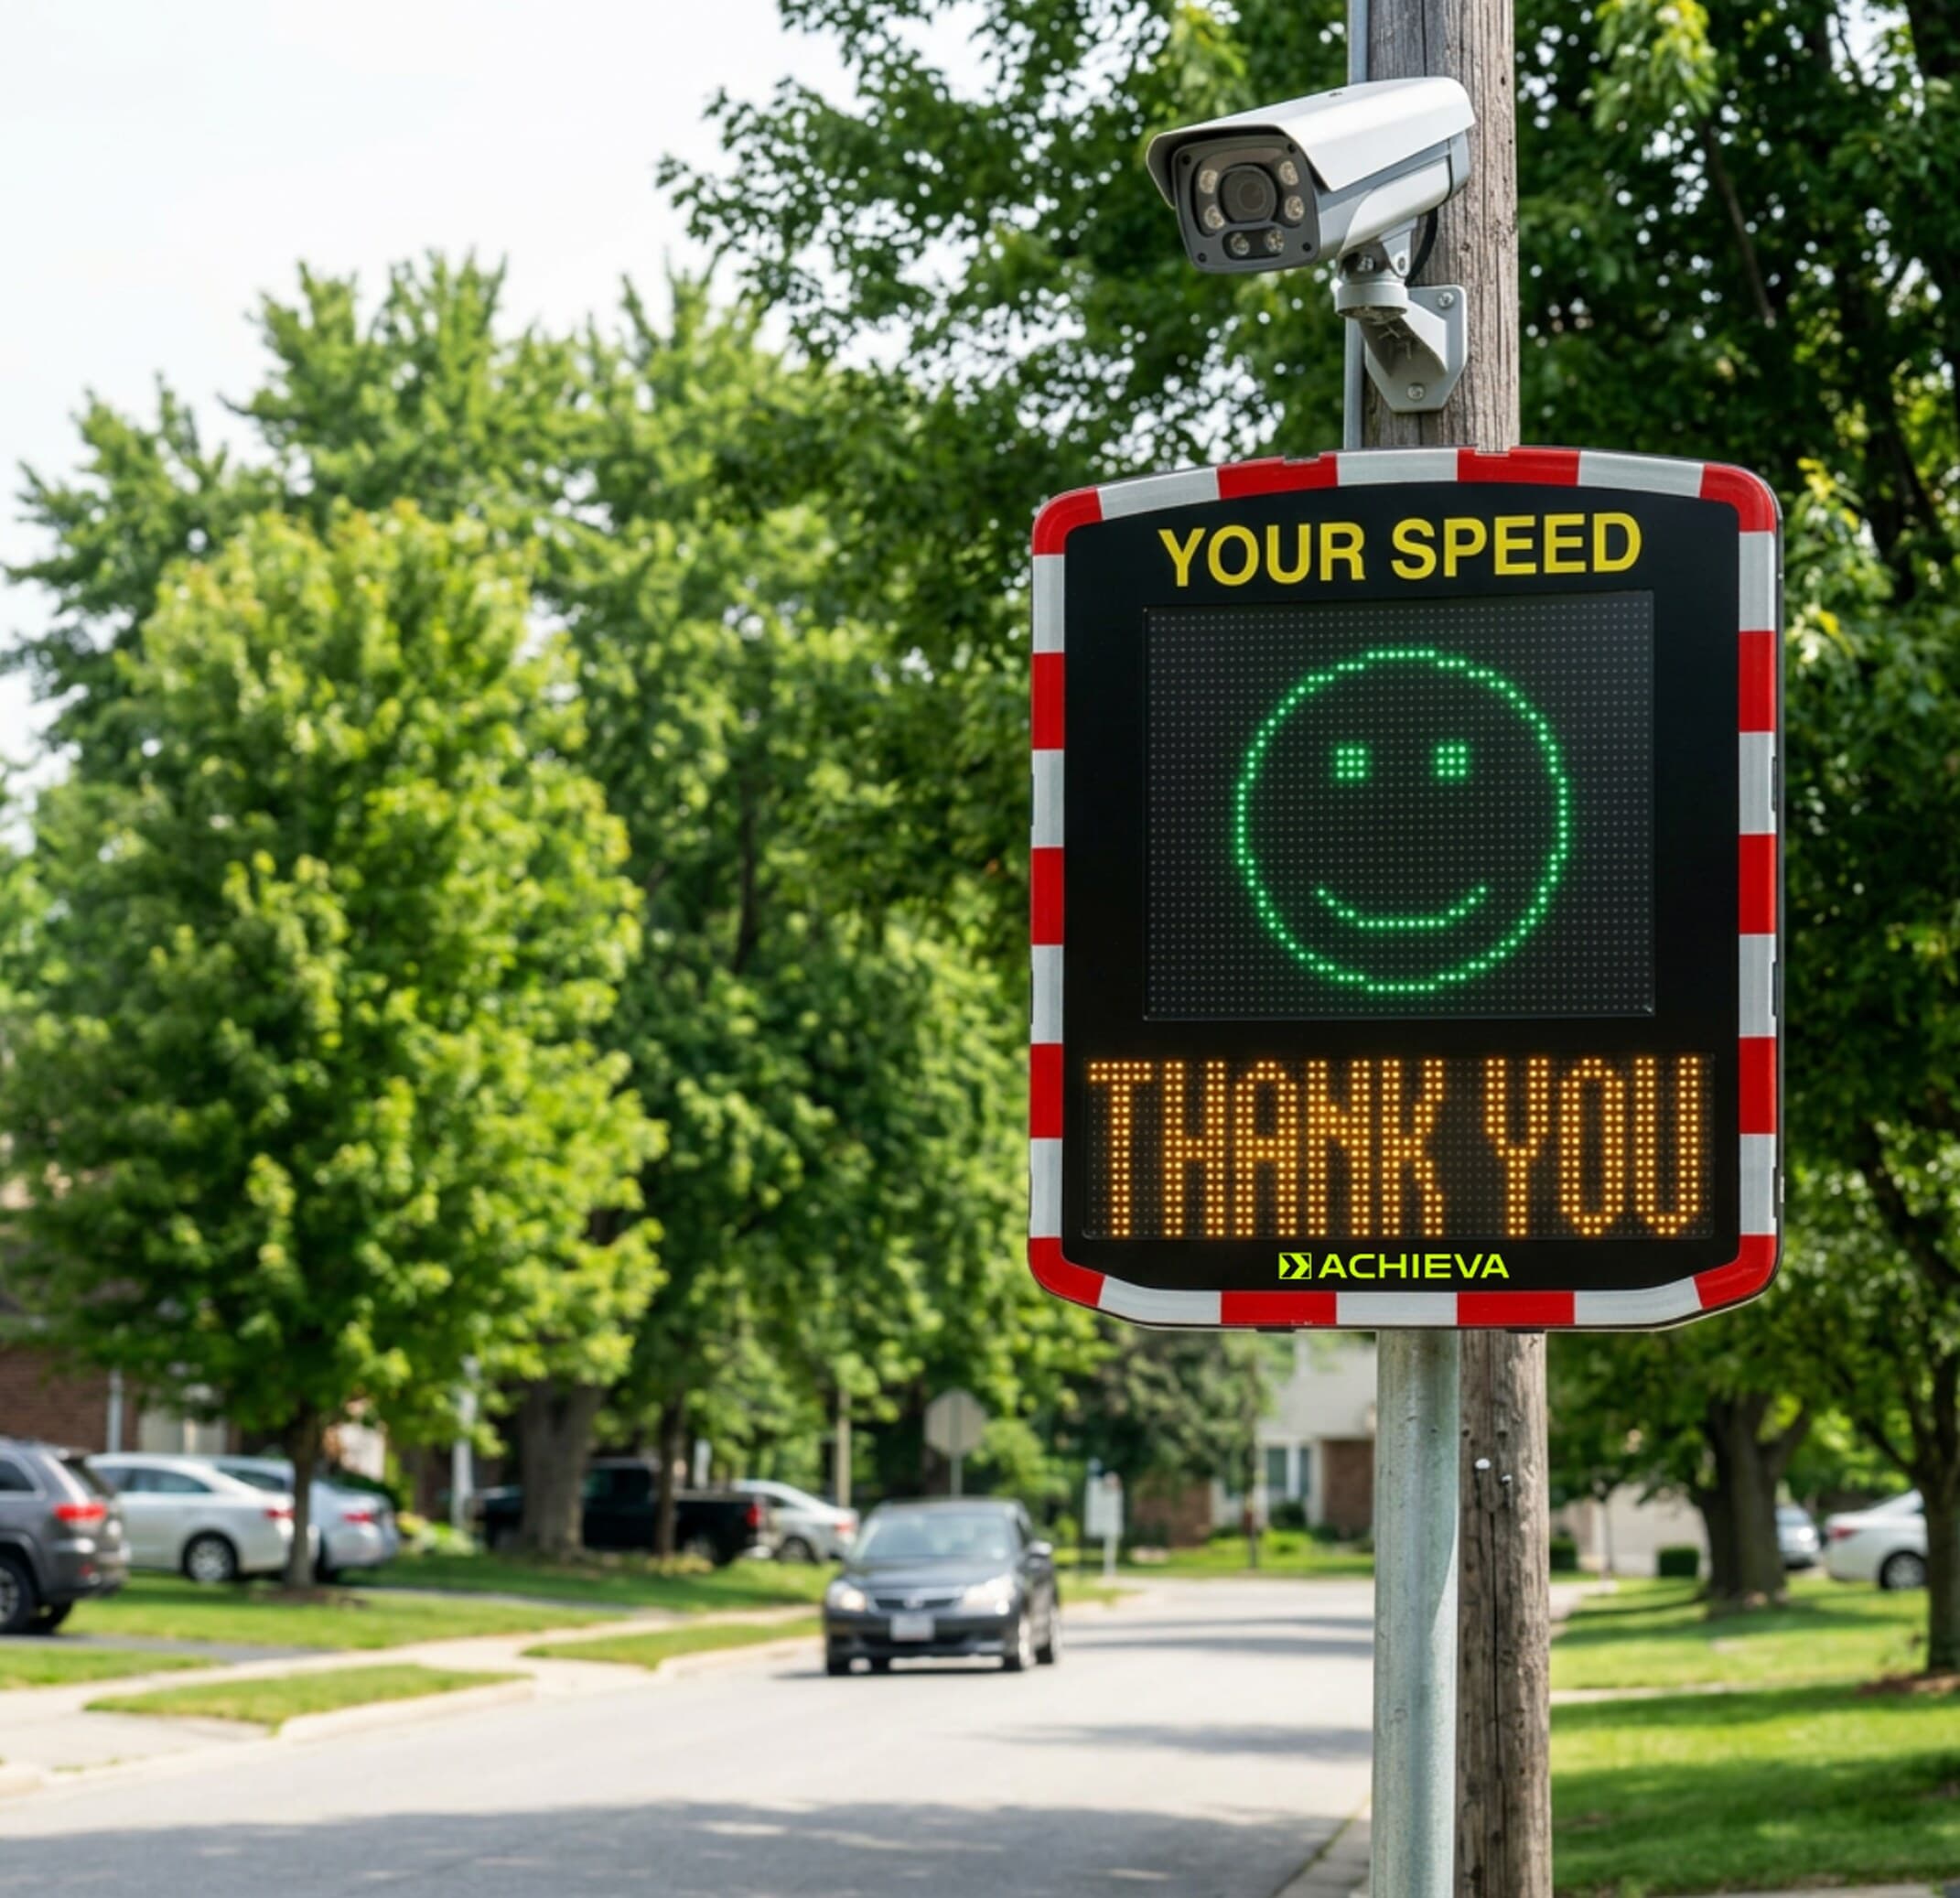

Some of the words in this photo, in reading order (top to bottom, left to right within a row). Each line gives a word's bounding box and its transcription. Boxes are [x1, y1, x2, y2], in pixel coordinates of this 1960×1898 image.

[1158, 522, 1365, 587] YOUR
[1392, 512, 1642, 580] SPEED
[1089, 1059, 1443, 1237] THANK
[1485, 1056, 1699, 1236] YOU
[1319, 1254, 1509, 1278] ACHIEVA
